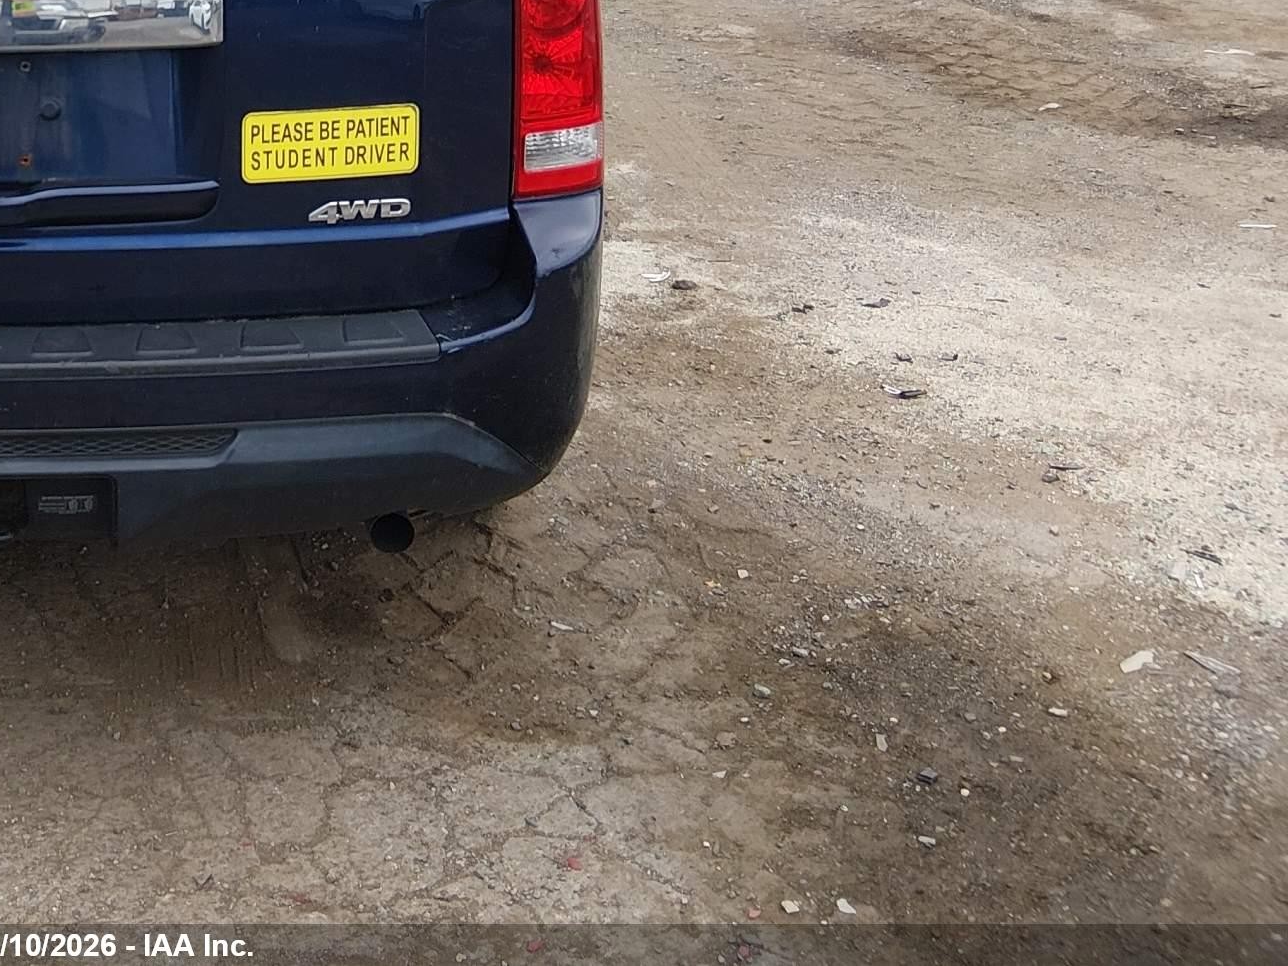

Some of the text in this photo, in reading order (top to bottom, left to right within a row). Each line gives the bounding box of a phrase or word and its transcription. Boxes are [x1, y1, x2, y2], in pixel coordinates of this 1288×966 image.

[250, 116, 410, 145] PLEASE BE PATIENT
[251, 142, 410, 171] STUDENT DRIVER
[308, 198, 411, 225] 4WD
